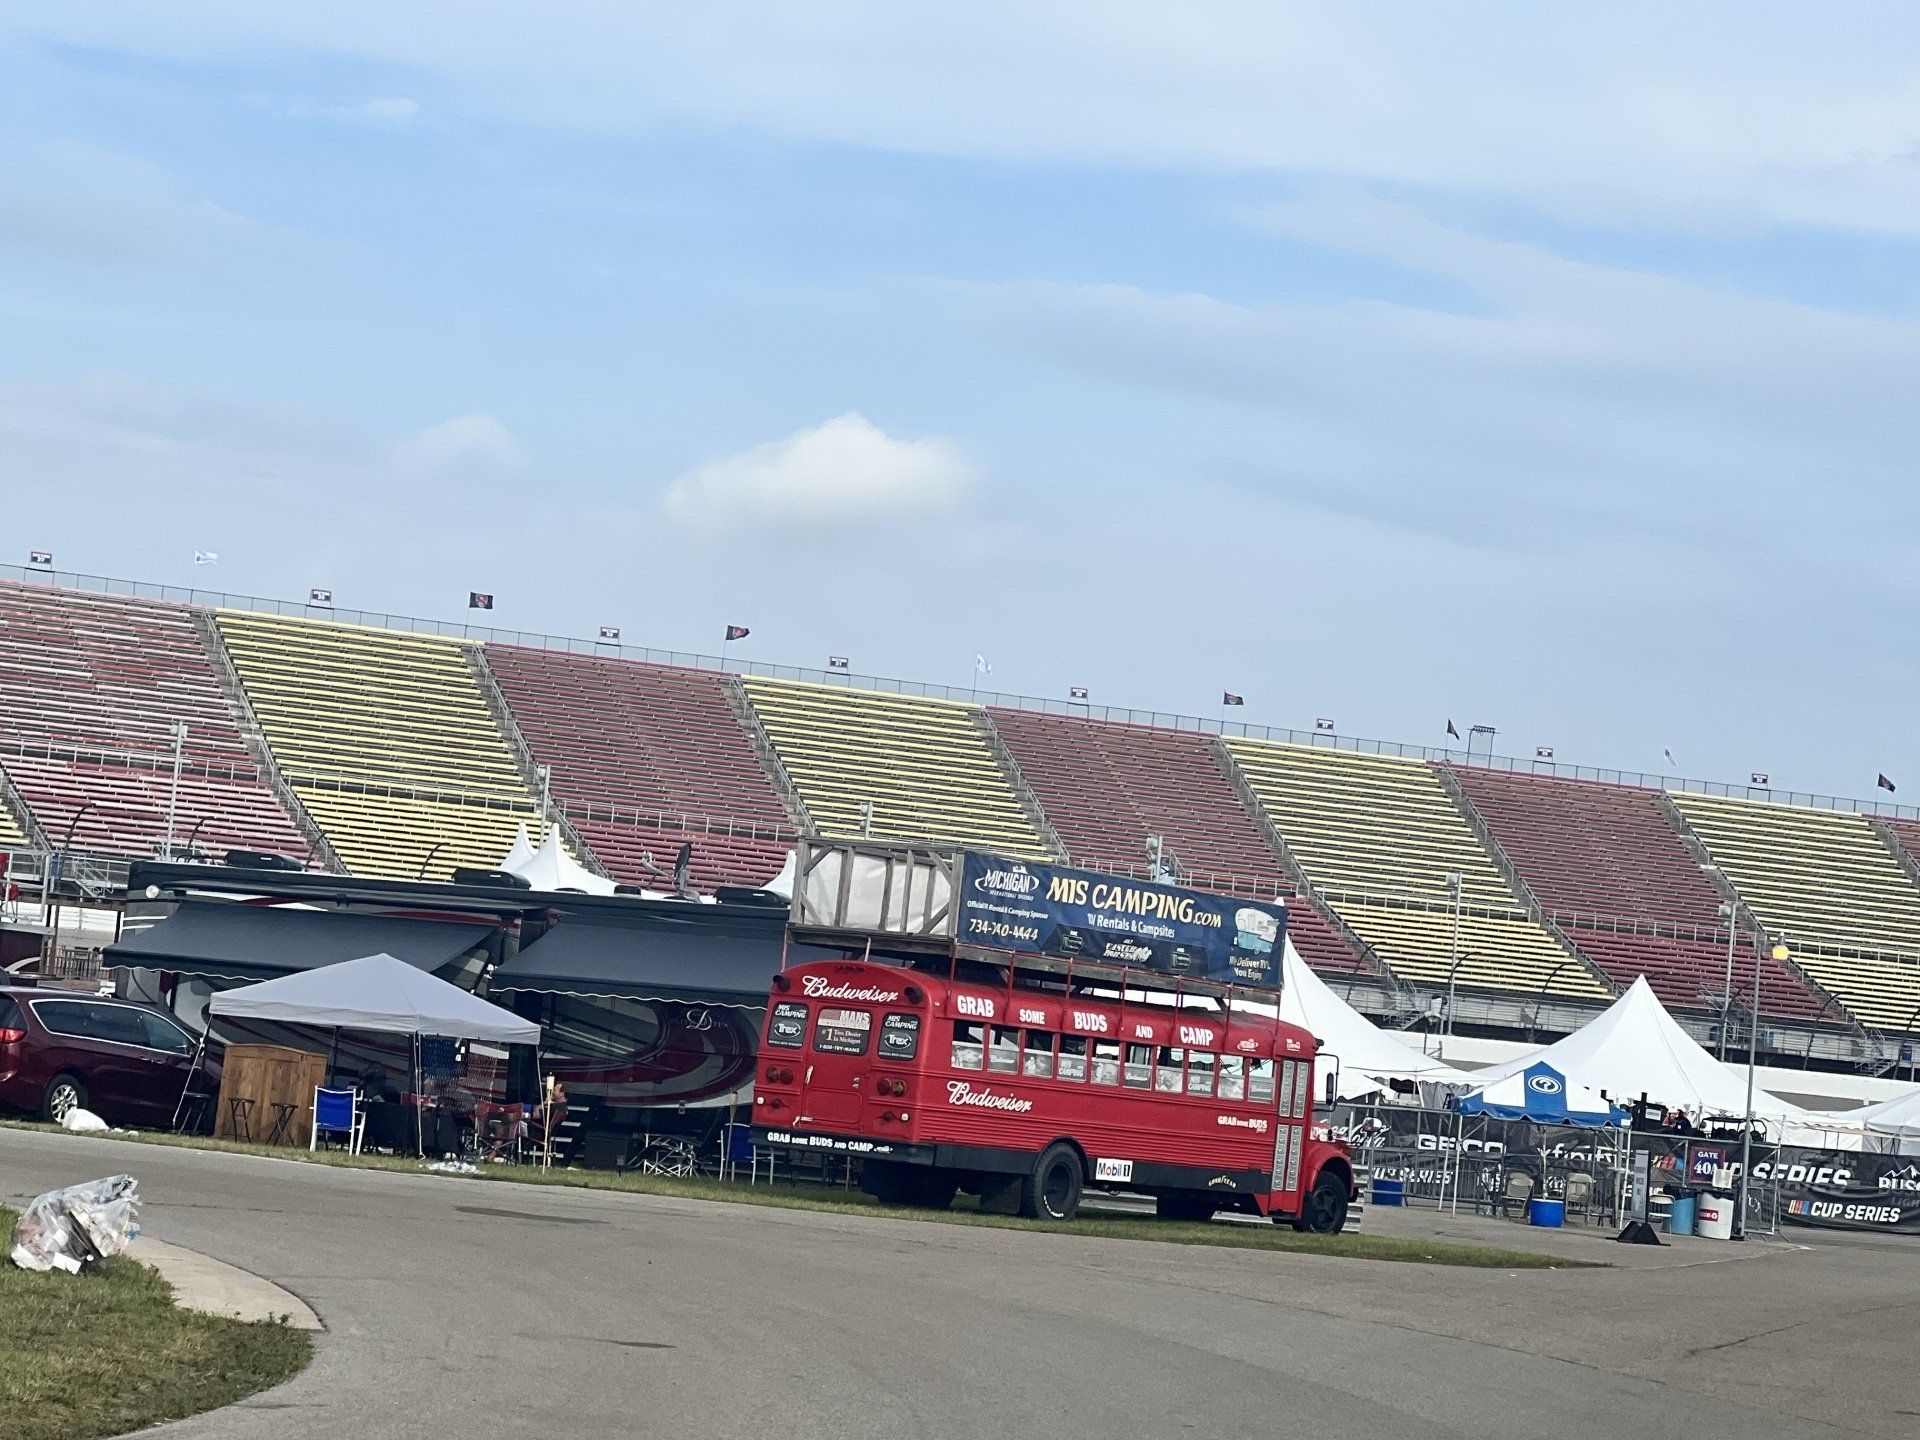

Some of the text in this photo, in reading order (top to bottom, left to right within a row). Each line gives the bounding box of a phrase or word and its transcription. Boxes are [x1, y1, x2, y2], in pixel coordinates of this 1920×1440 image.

[983, 869, 1031, 893] MICHIGAN
[1046, 877, 1090, 906] MIS
[1008, 908, 1030, 918] Camping
[1030, 911, 1049, 919] Sponsor
[1097, 914, 1130, 931] Rentals
[1131, 920, 1137, 932] &
[1138, 921, 1175, 938] Campsites
[802, 975, 899, 1003] Budweiser
[775, 1010, 806, 1018] CAMPING
[839, 1010, 870, 1024] MANS
[957, 995, 994, 1018] GRAB
[1019, 1009, 1045, 1025] SOME
[1074, 1011, 1108, 1032] BUDS
[1135, 1025, 1153, 1039] AND
[1180, 1026, 1214, 1046] CAMP
[778, 1023, 798, 1034] Trex
[885, 1021, 917, 1029] CAMPING
[889, 1034, 909, 1045] Trex
[946, 1080, 1033, 1113] Budweiser
[1217, 1115, 1237, 1126] GRAB
[1249, 1119, 1267, 1129] BUDS
[767, 1132, 791, 1143] GRAB
[809, 1136, 834, 1148] BUDS
[834, 1141, 847, 1149] AND
[848, 1141, 874, 1152] CAMP
[1418, 1133, 1504, 1153] GEICO
[1697, 1151, 1719, 1160] GATE
[1098, 1163, 1122, 1177] Mobil
[1811, 1201, 1901, 1224] CUP SERIES
